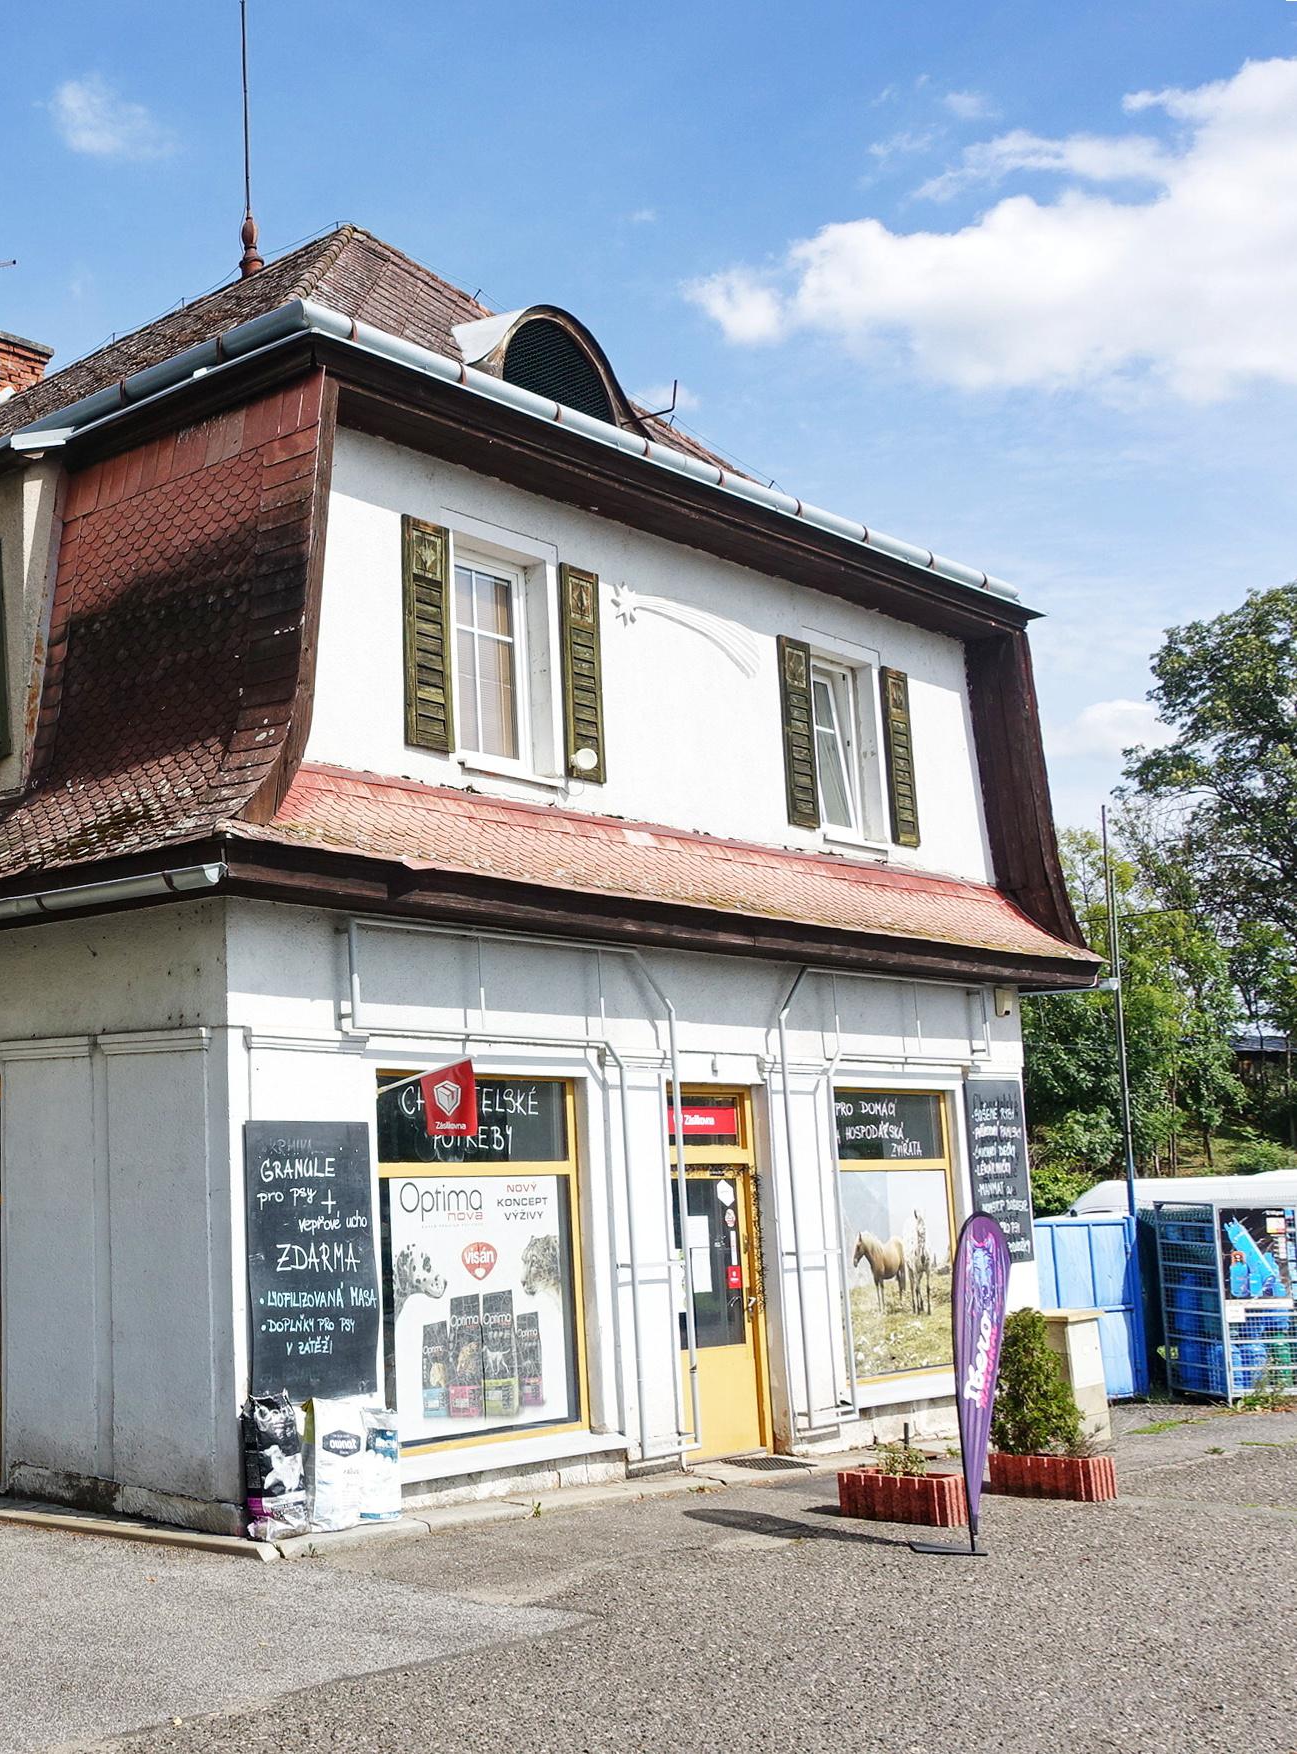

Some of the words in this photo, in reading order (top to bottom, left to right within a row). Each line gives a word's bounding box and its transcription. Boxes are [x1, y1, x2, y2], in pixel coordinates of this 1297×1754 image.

[401, 1085, 539, 1116] CHELSKÉ
[835, 1101, 853, 1117] PRO
[859, 1098, 897, 1118] DOMÁCÍ
[890, 1137, 923, 1157] ZVÍŘATA
[260, 1157, 336, 1183] GRANULE
[506, 1181, 537, 1193] NOVÝ
[256, 1190, 284, 1211] pro
[289, 1186, 318, 1207] psy
[399, 1181, 483, 1222] Optima
[496, 1196, 549, 1208] KONCEPT
[298, 1209, 342, 1235] vepřové
[345, 1209, 368, 1229] ucho
[447, 1211, 484, 1222] nova
[504, 1208, 544, 1221] VÝŽIVY
[275, 1241, 361, 1273] ZDARMA
[267, 1281, 344, 1309] LYOFILIZOVANÁ
[350, 1286, 378, 1309] MASA
[267, 1313, 315, 1333] DOPLŇKY
[317, 1317, 335, 1332] PRO
[339, 1317, 356, 1334] PSY
[286, 1341, 294, 1356] V
